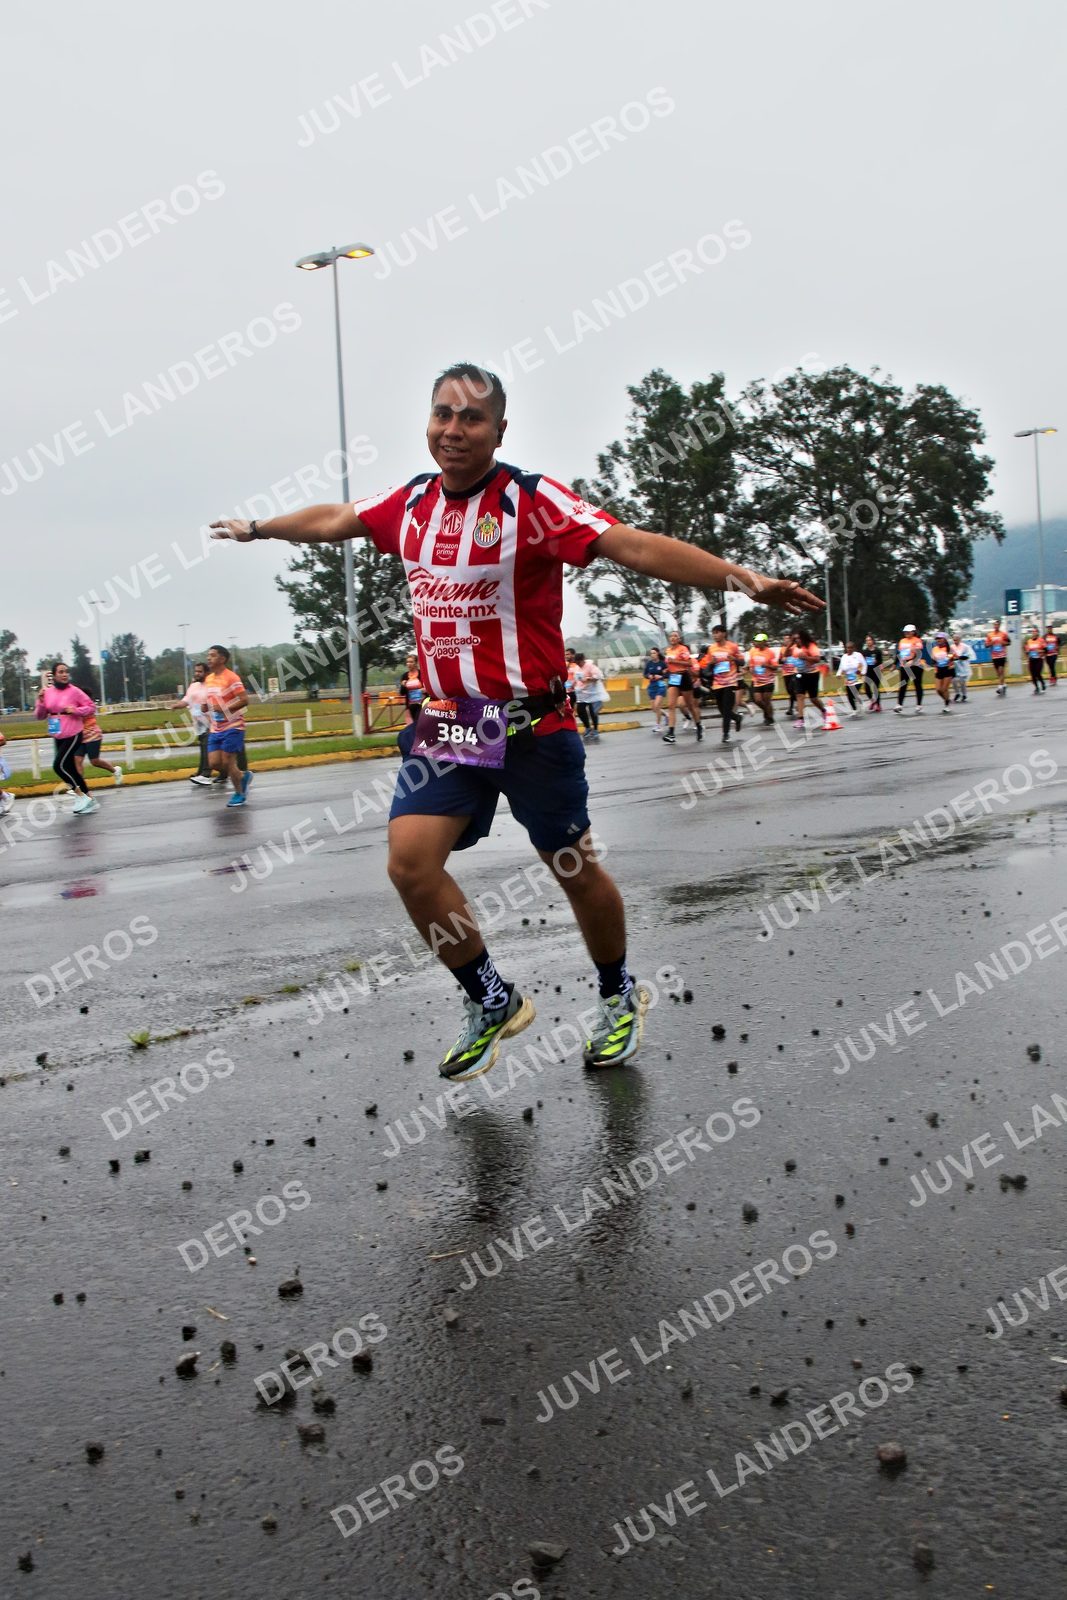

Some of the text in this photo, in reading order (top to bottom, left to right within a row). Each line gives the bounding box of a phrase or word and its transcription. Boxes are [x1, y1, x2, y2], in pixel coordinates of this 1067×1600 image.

[443, 512, 462, 535] MG
[436, 548, 454, 556] prime
[408, 566, 500, 602] Caliente
[1008, 600, 1017, 612] E
[436, 635, 479, 645] mercado
[437, 647, 460, 658] pago
[482, 704, 500, 719] 15K
[437, 722, 478, 746] 384
